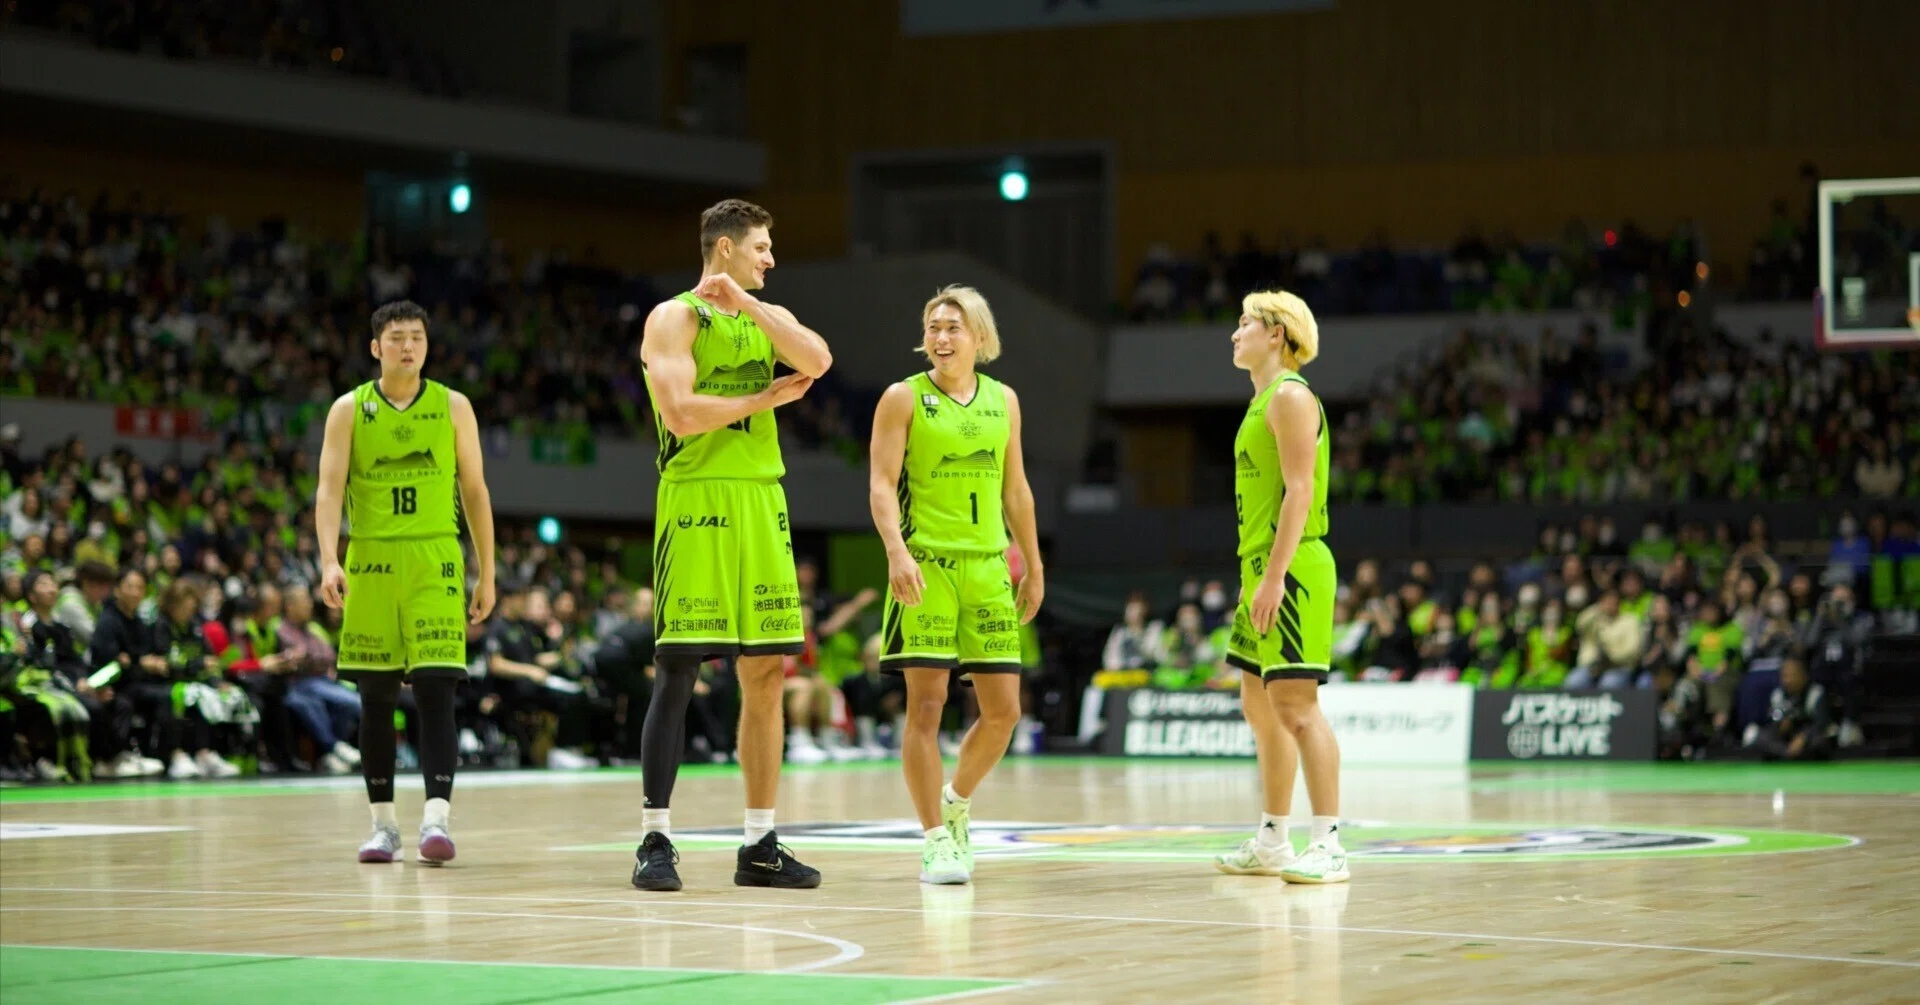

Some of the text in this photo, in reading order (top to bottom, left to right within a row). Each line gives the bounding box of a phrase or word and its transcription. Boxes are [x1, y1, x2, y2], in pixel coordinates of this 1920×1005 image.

[931, 470, 980, 479] Diamond
[391, 486, 417, 515] 18
[969, 492, 978, 525] 1
[695, 516, 730, 528] JAL
[362, 563, 395, 574] JAL
[441, 562, 456, 578] 18
[1251, 557, 1263, 576] 12
[1502, 692, 1625, 726] バスケット
[1540, 723, 1612, 756] LIVE
